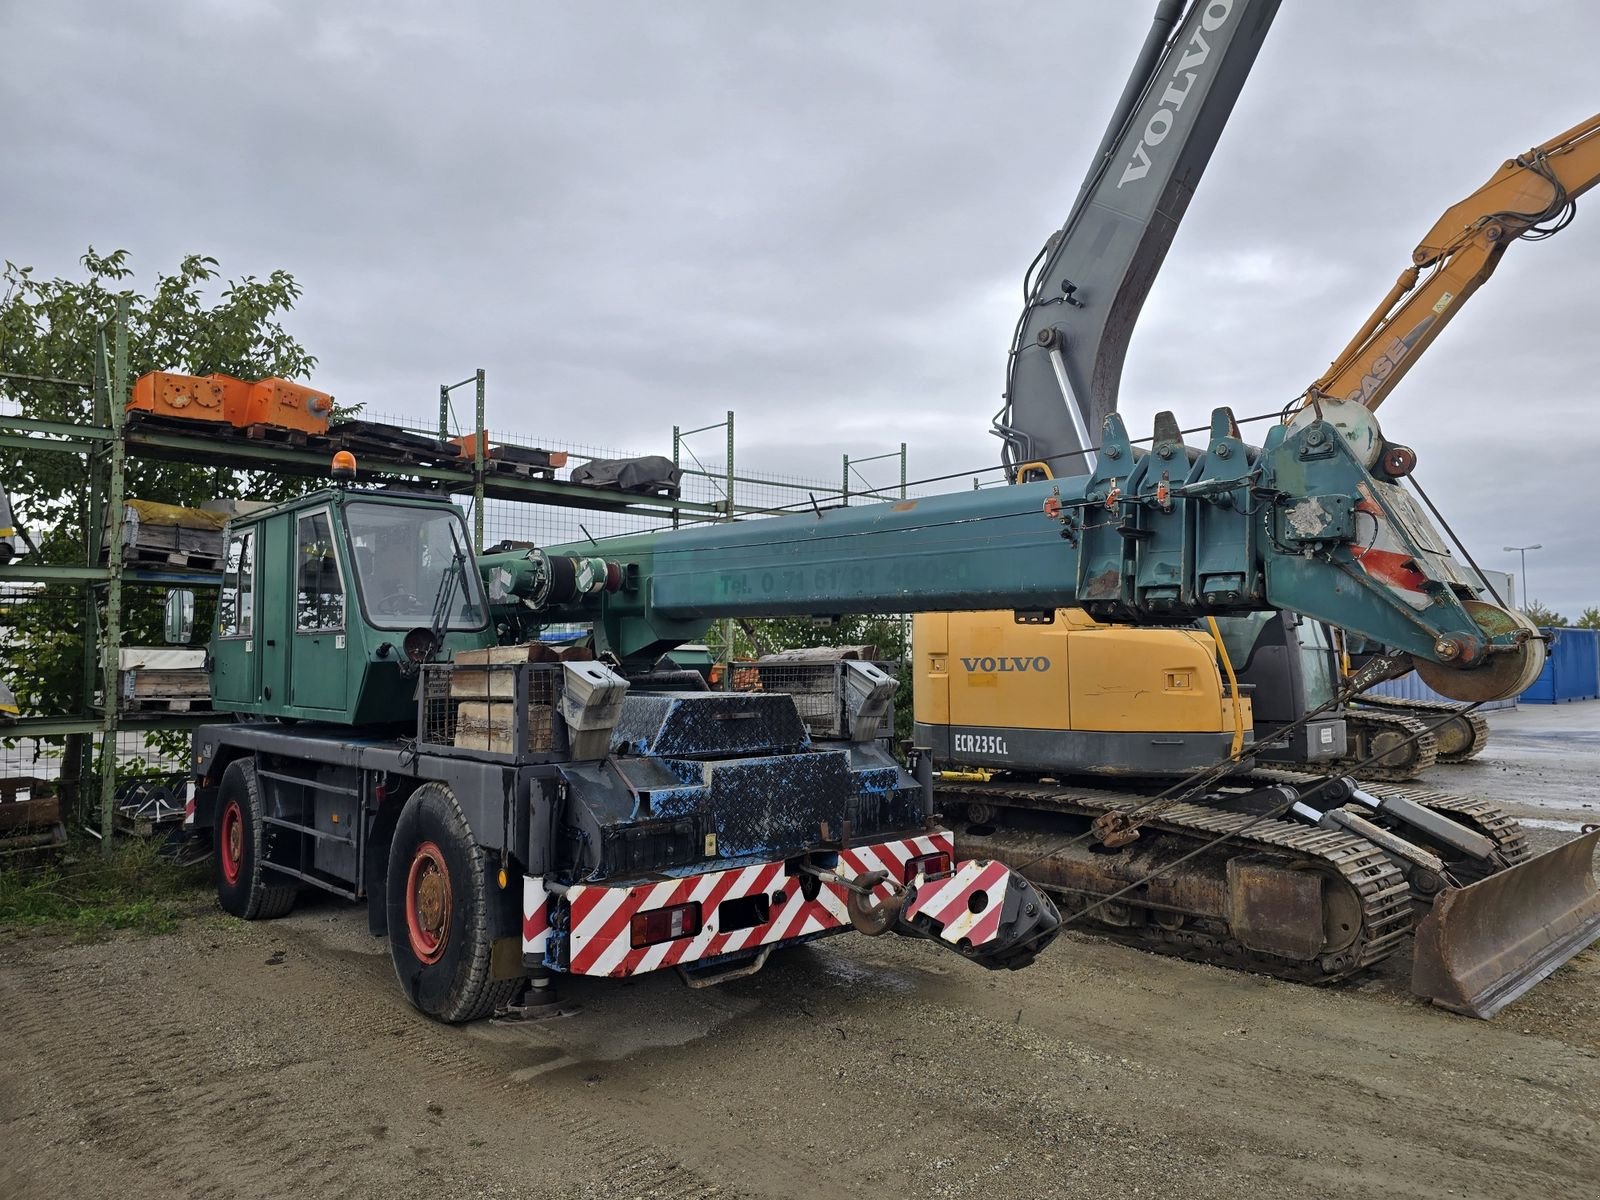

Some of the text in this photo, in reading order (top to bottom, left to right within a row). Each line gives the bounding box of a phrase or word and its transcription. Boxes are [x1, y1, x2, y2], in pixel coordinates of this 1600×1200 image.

[1117, 0, 1234, 189] VOLVO
[720, 575, 751, 594] Tel.
[761, 574, 774, 593] 0
[960, 656, 1050, 672] VOLVO
